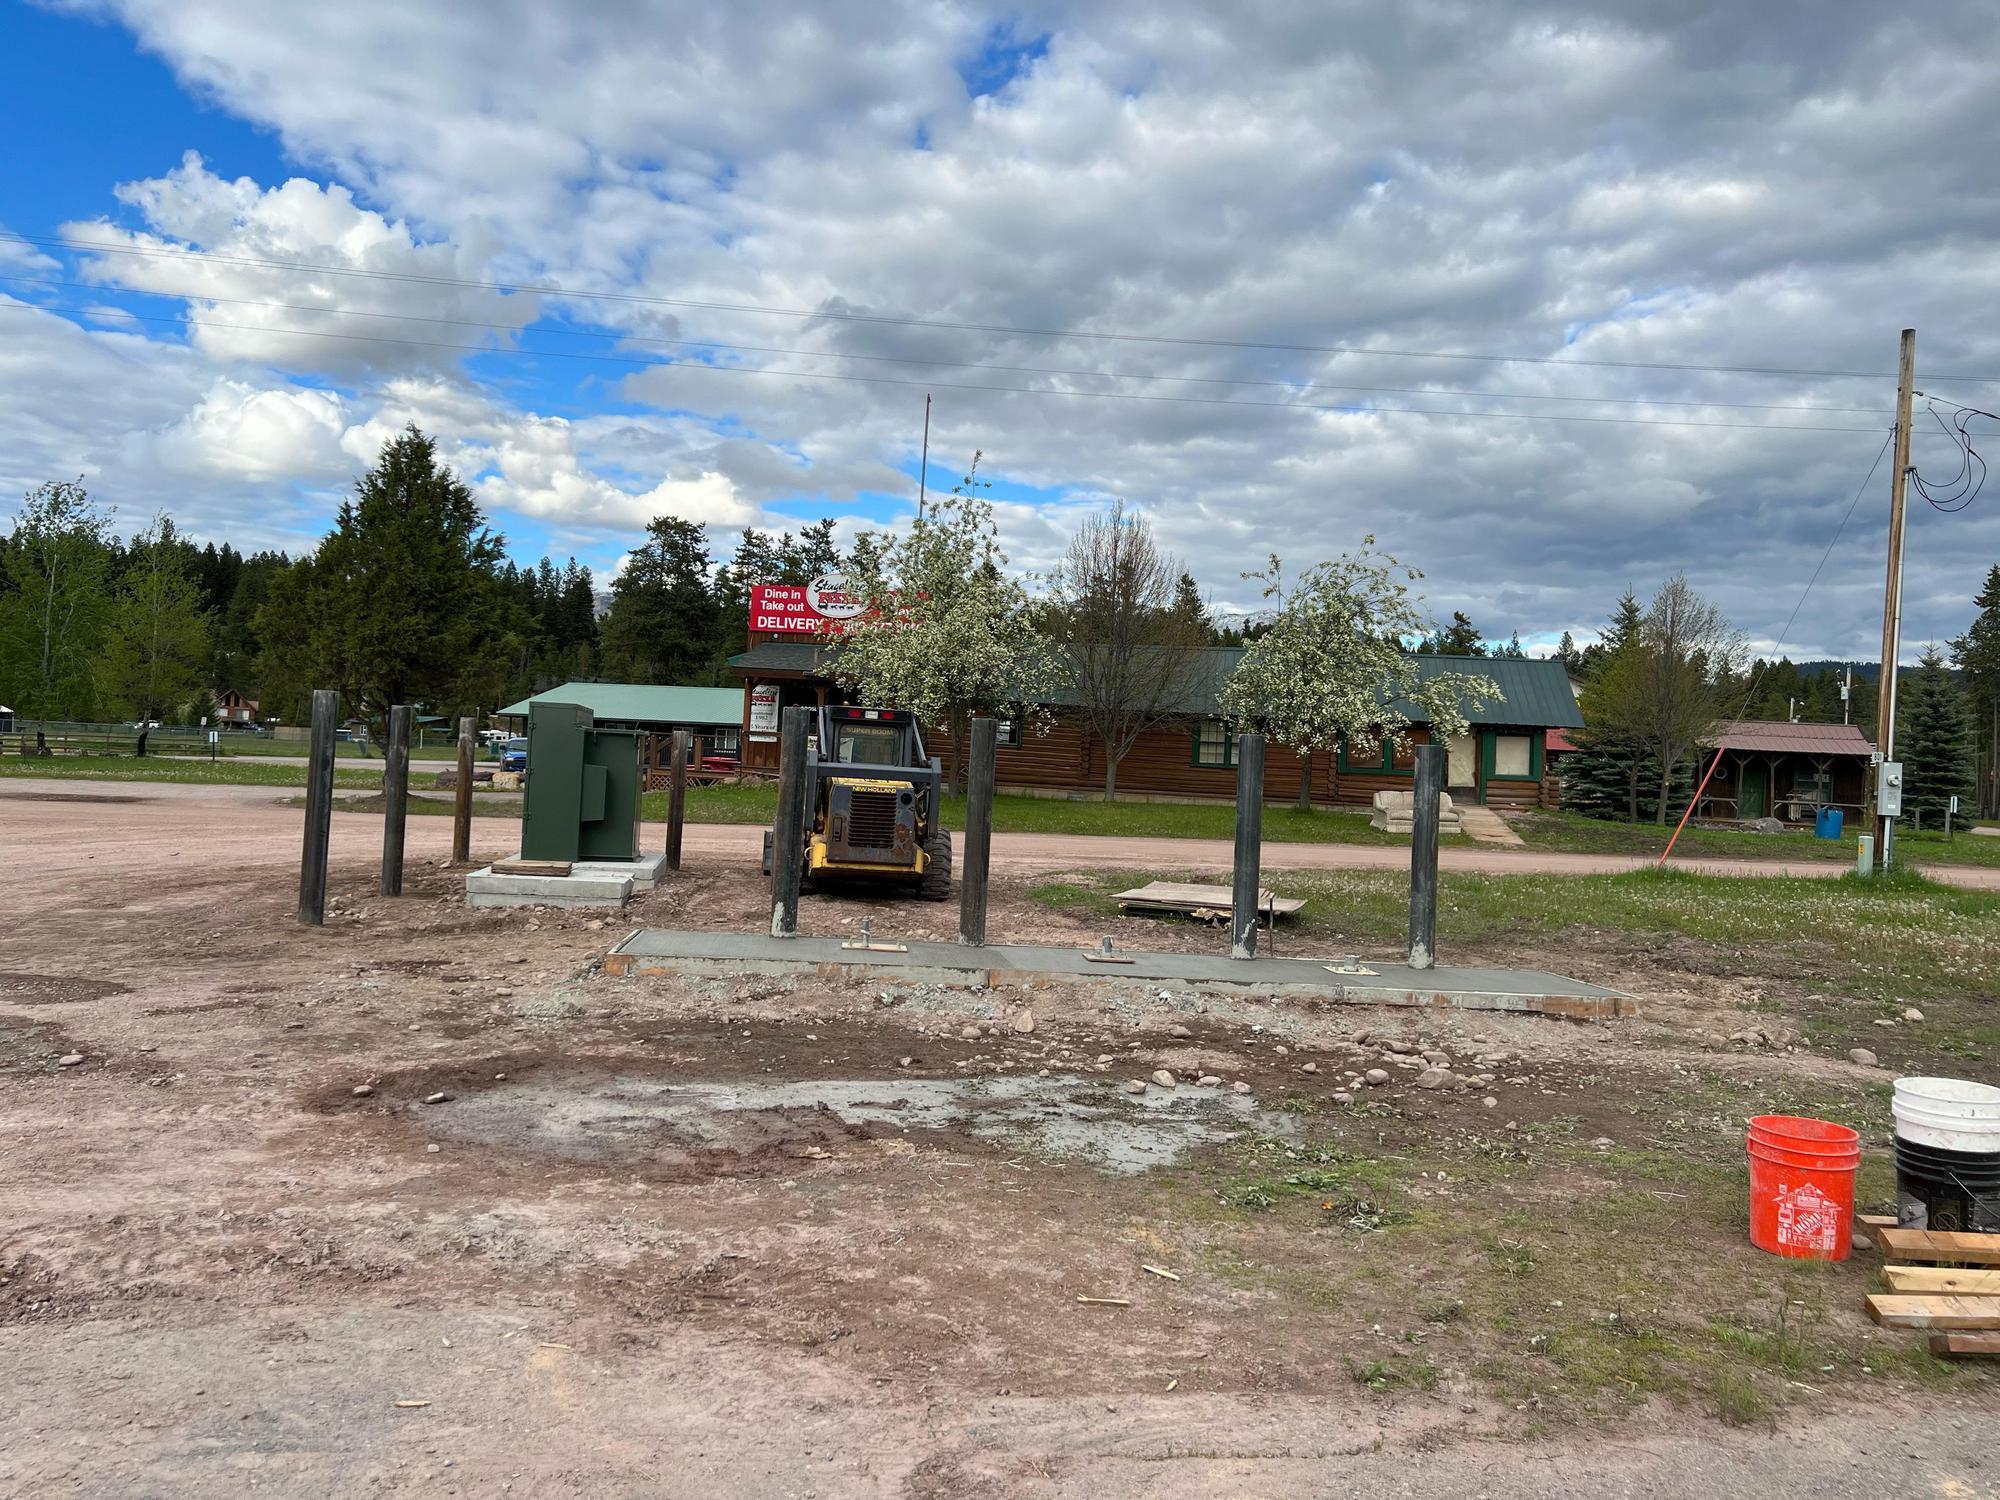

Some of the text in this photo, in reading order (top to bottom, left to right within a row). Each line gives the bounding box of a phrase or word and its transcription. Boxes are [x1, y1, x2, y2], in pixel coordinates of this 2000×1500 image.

[764, 588, 801, 600] Dine in
[760, 600, 804, 612] Take out
[757, 615, 822, 630] DELIVERY
[1793, 1211, 1822, 1234] HOME
